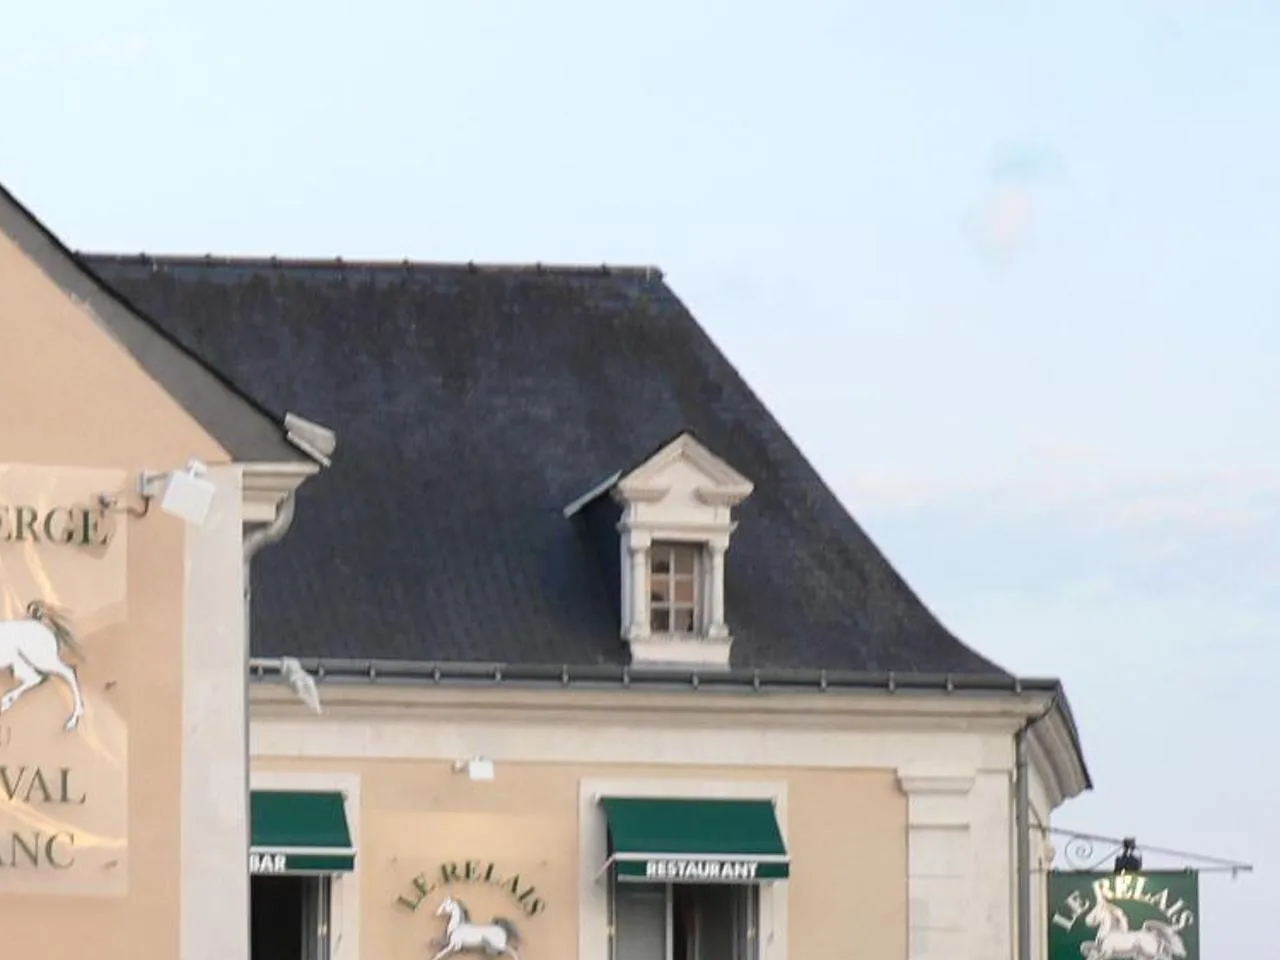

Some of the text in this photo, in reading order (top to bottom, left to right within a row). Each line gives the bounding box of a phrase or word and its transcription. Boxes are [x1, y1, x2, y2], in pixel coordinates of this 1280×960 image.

[249, 854, 287, 873] BAR
[646, 860, 759, 879] RESTAURANT
[397, 860, 546, 917] LE RELAIS
[1052, 873, 1194, 933] LE RELAIS
